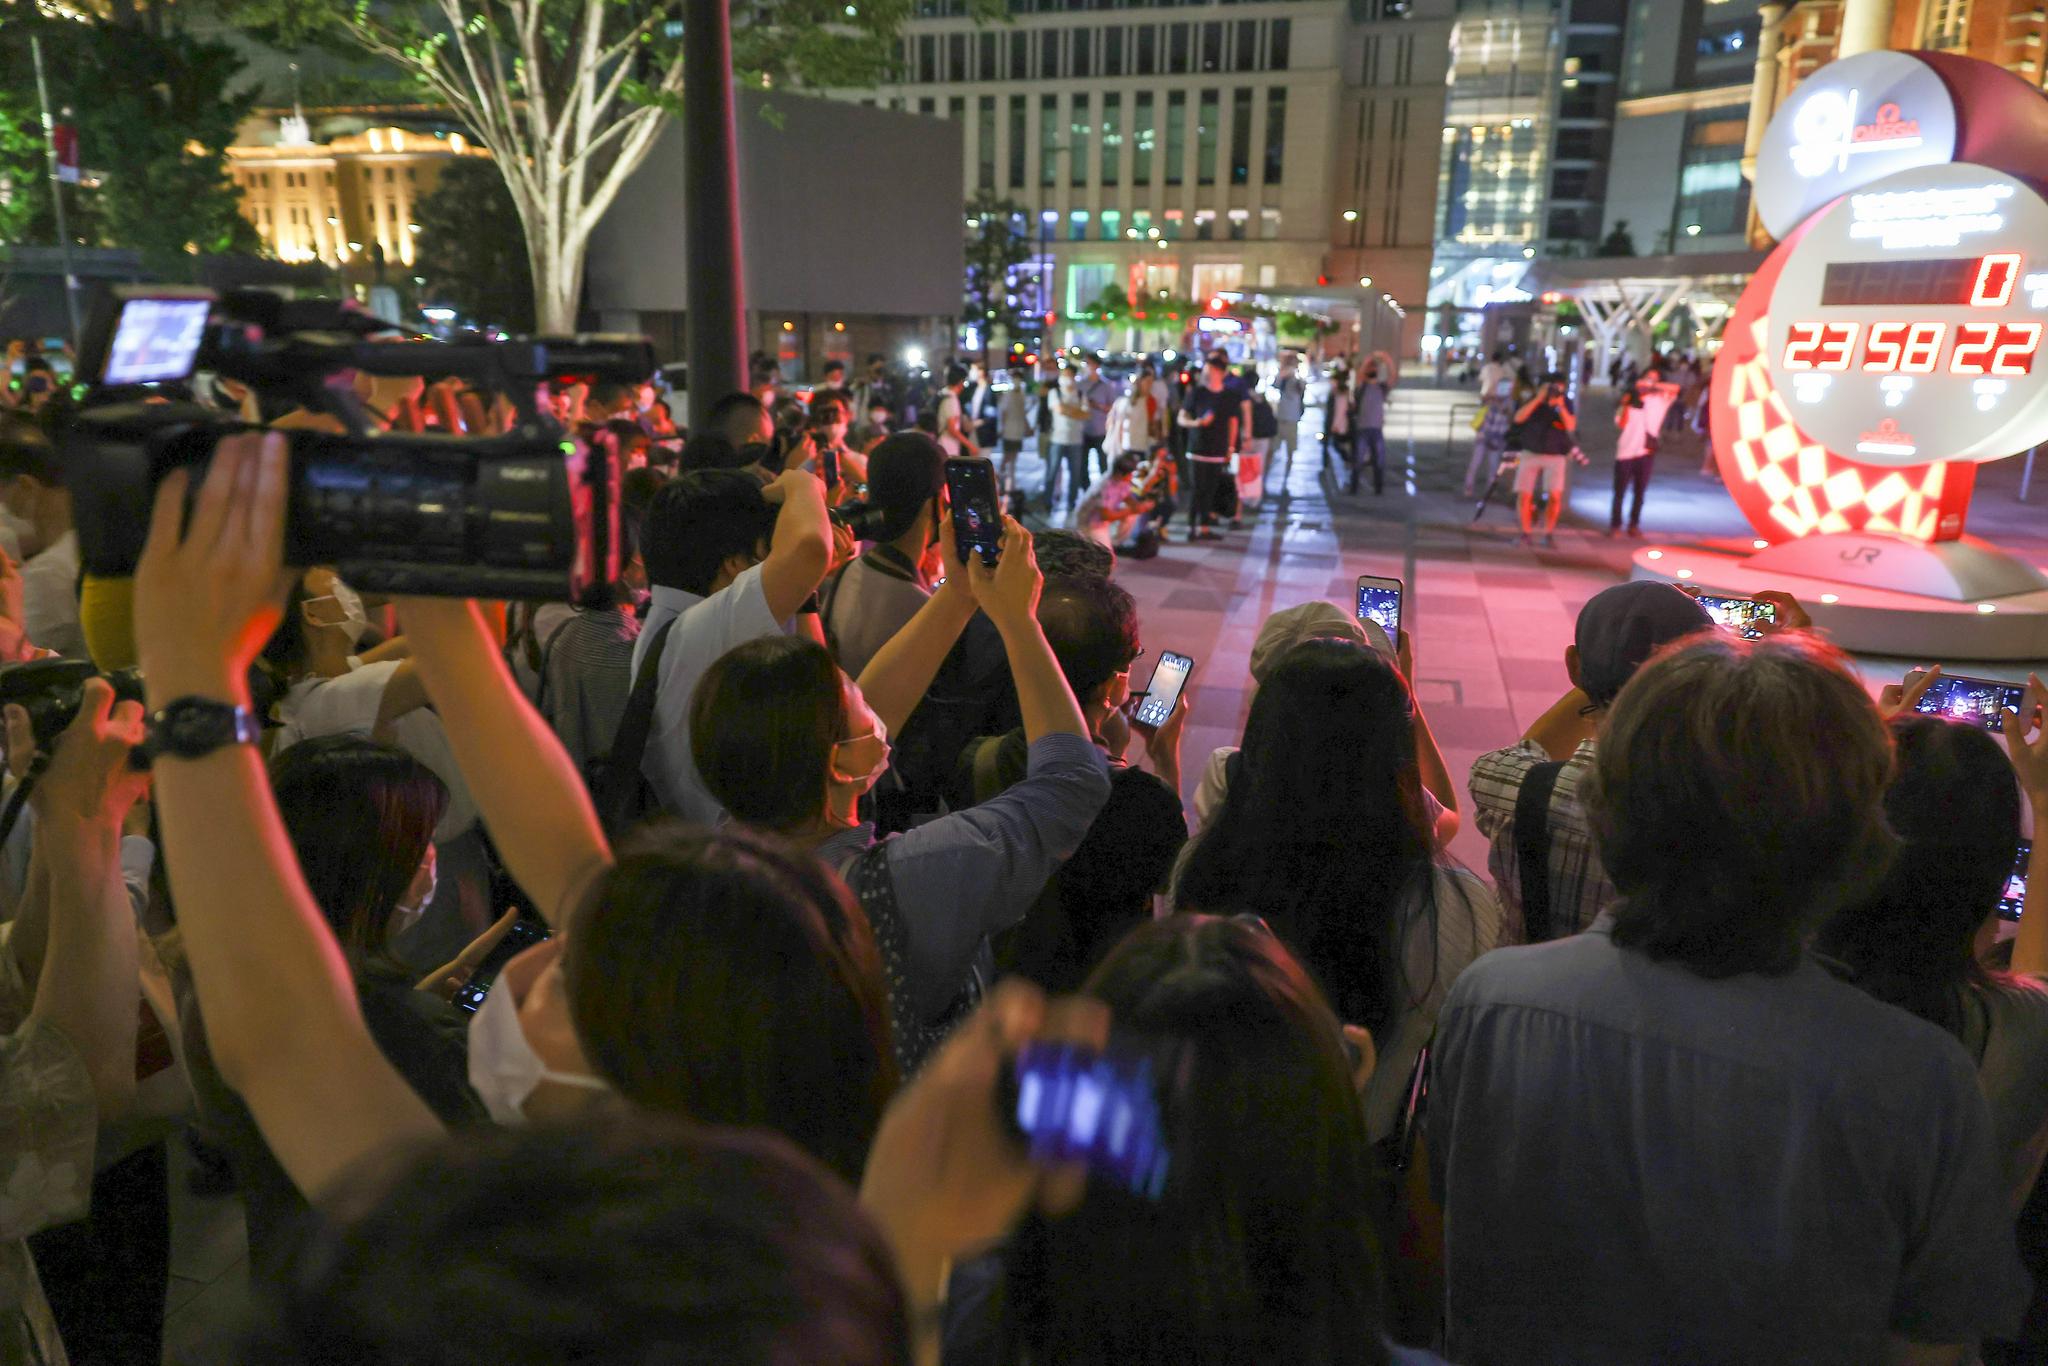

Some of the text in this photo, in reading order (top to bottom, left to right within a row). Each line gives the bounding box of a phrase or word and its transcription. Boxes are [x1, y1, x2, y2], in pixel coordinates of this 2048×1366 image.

[1971, 254, 2022, 306] 0
[1783, 322, 2043, 375] 23 58 22
[1838, 546, 1881, 563] JR
